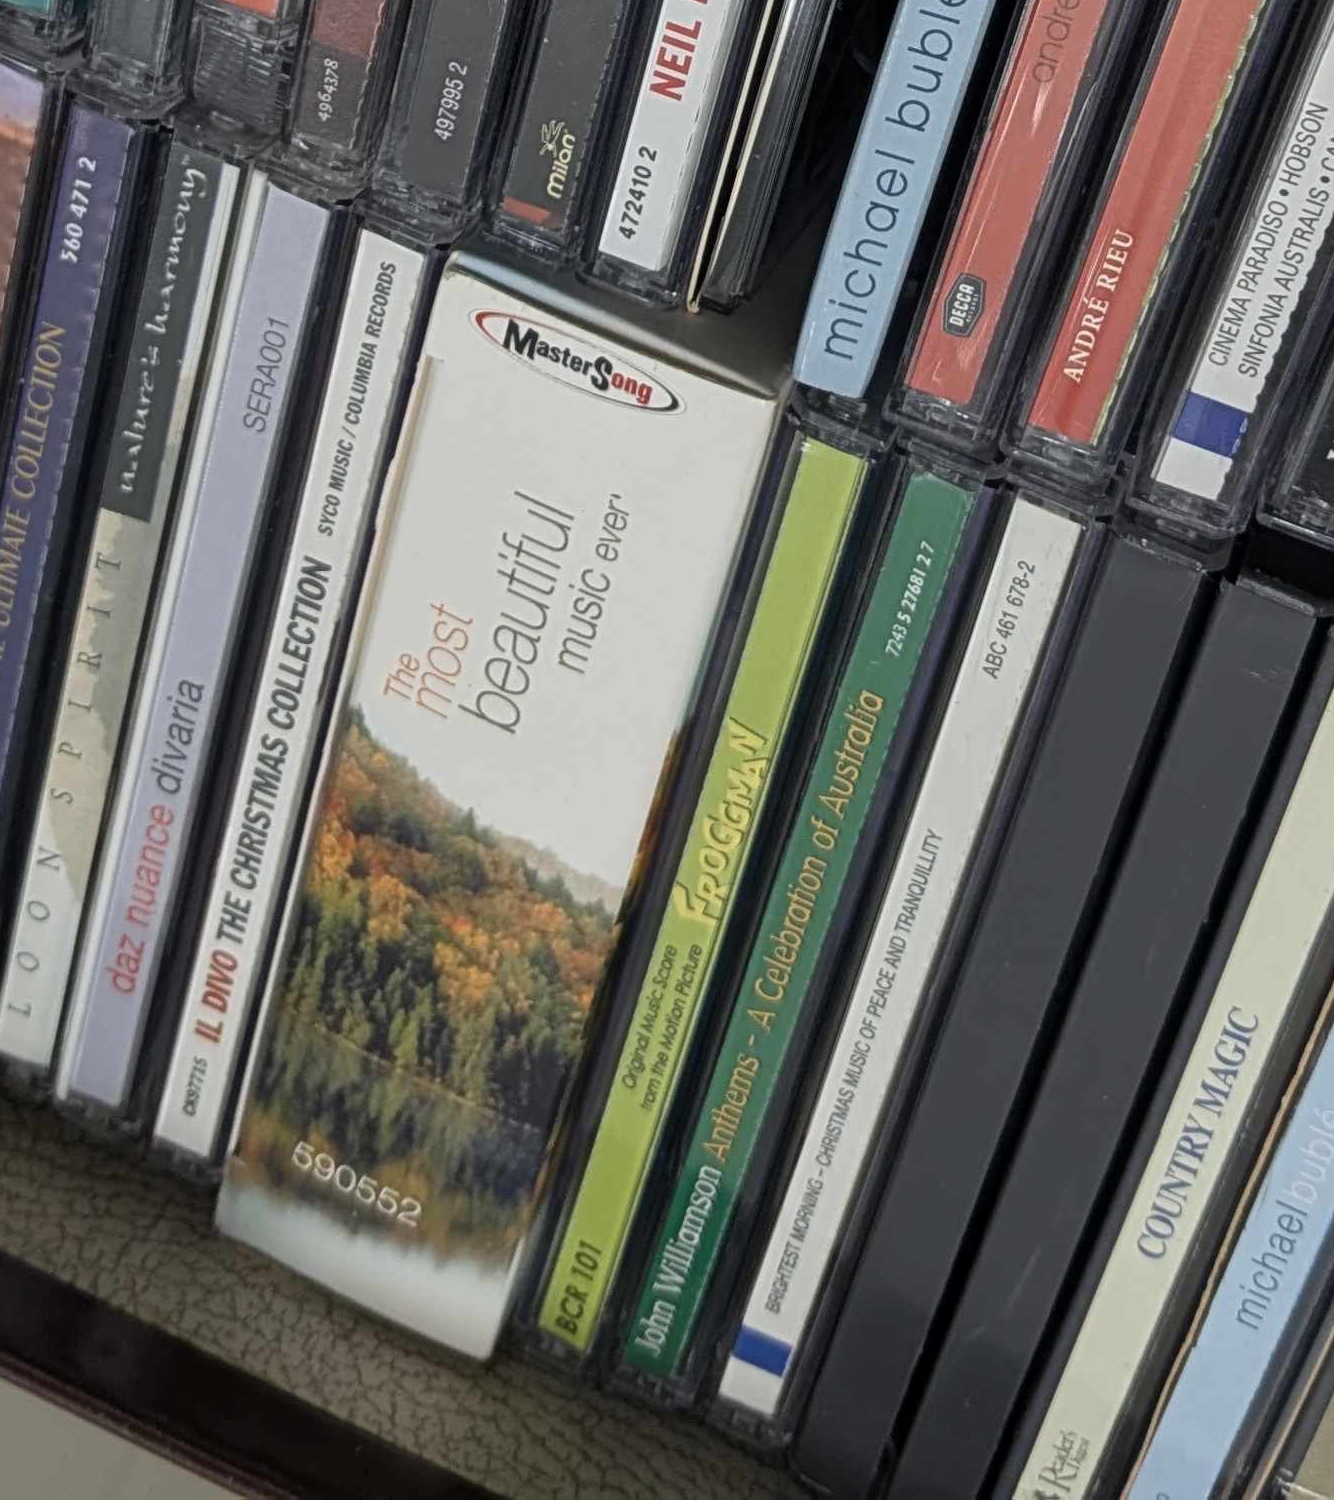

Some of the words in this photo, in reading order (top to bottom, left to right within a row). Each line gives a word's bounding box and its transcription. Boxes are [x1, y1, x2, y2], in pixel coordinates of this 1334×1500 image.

[650, 21, 700, 99] NEIL
[145, 168, 205, 333] harmony
[618, 165, 651, 238] 472410
[825, 150, 913, 358] michael
[1208, 297, 1251, 365] CINEMA
[1236, 200, 1287, 292] PARADISO
[1279, 102, 1327, 185] HOBSON
[1237, 294, 1287, 377] SINFONIA
[1274, 187, 1329, 291] AUSTRALIS
[325, 437, 356, 493] MUSIC
[342, 339, 378, 426] COLUMBIA
[363, 259, 398, 338] RECORDS
[502, 318, 654, 405] MasterSong
[1063, 296, 1108, 382] ANDRÉ
[1095, 229, 1132, 291] RIEU
[11, 322, 64, 498] COLLECTION
[50, 549, 122, 803] SPIRIT
[267, 557, 329, 729] COLLECTION
[457, 489, 576, 736] beautiful
[556, 567, 612, 676] music
[982, 641, 1007, 679] ABC
[126, 801, 173, 926] nuance
[151, 679, 203, 794] divaria
[228, 732, 292, 892] CHRISTMAS
[216, 890, 255, 945] THE
[654, 1166, 720, 1300] Williamson
[704, 1053, 758, 1157] Anthems
[755, 856, 826, 1000] Celebration
[820, 690, 882, 816] Australia
[814, 1085, 856, 1167] CHRISTMAS
[1137, 1115, 1212, 1258] COUNTRY
[1193, 1006, 1258, 1115] MAGIC
[555, 1286, 590, 1334] BCR
[571, 1240, 604, 1280] 101
[1236, 1200, 1306, 1329] michael
